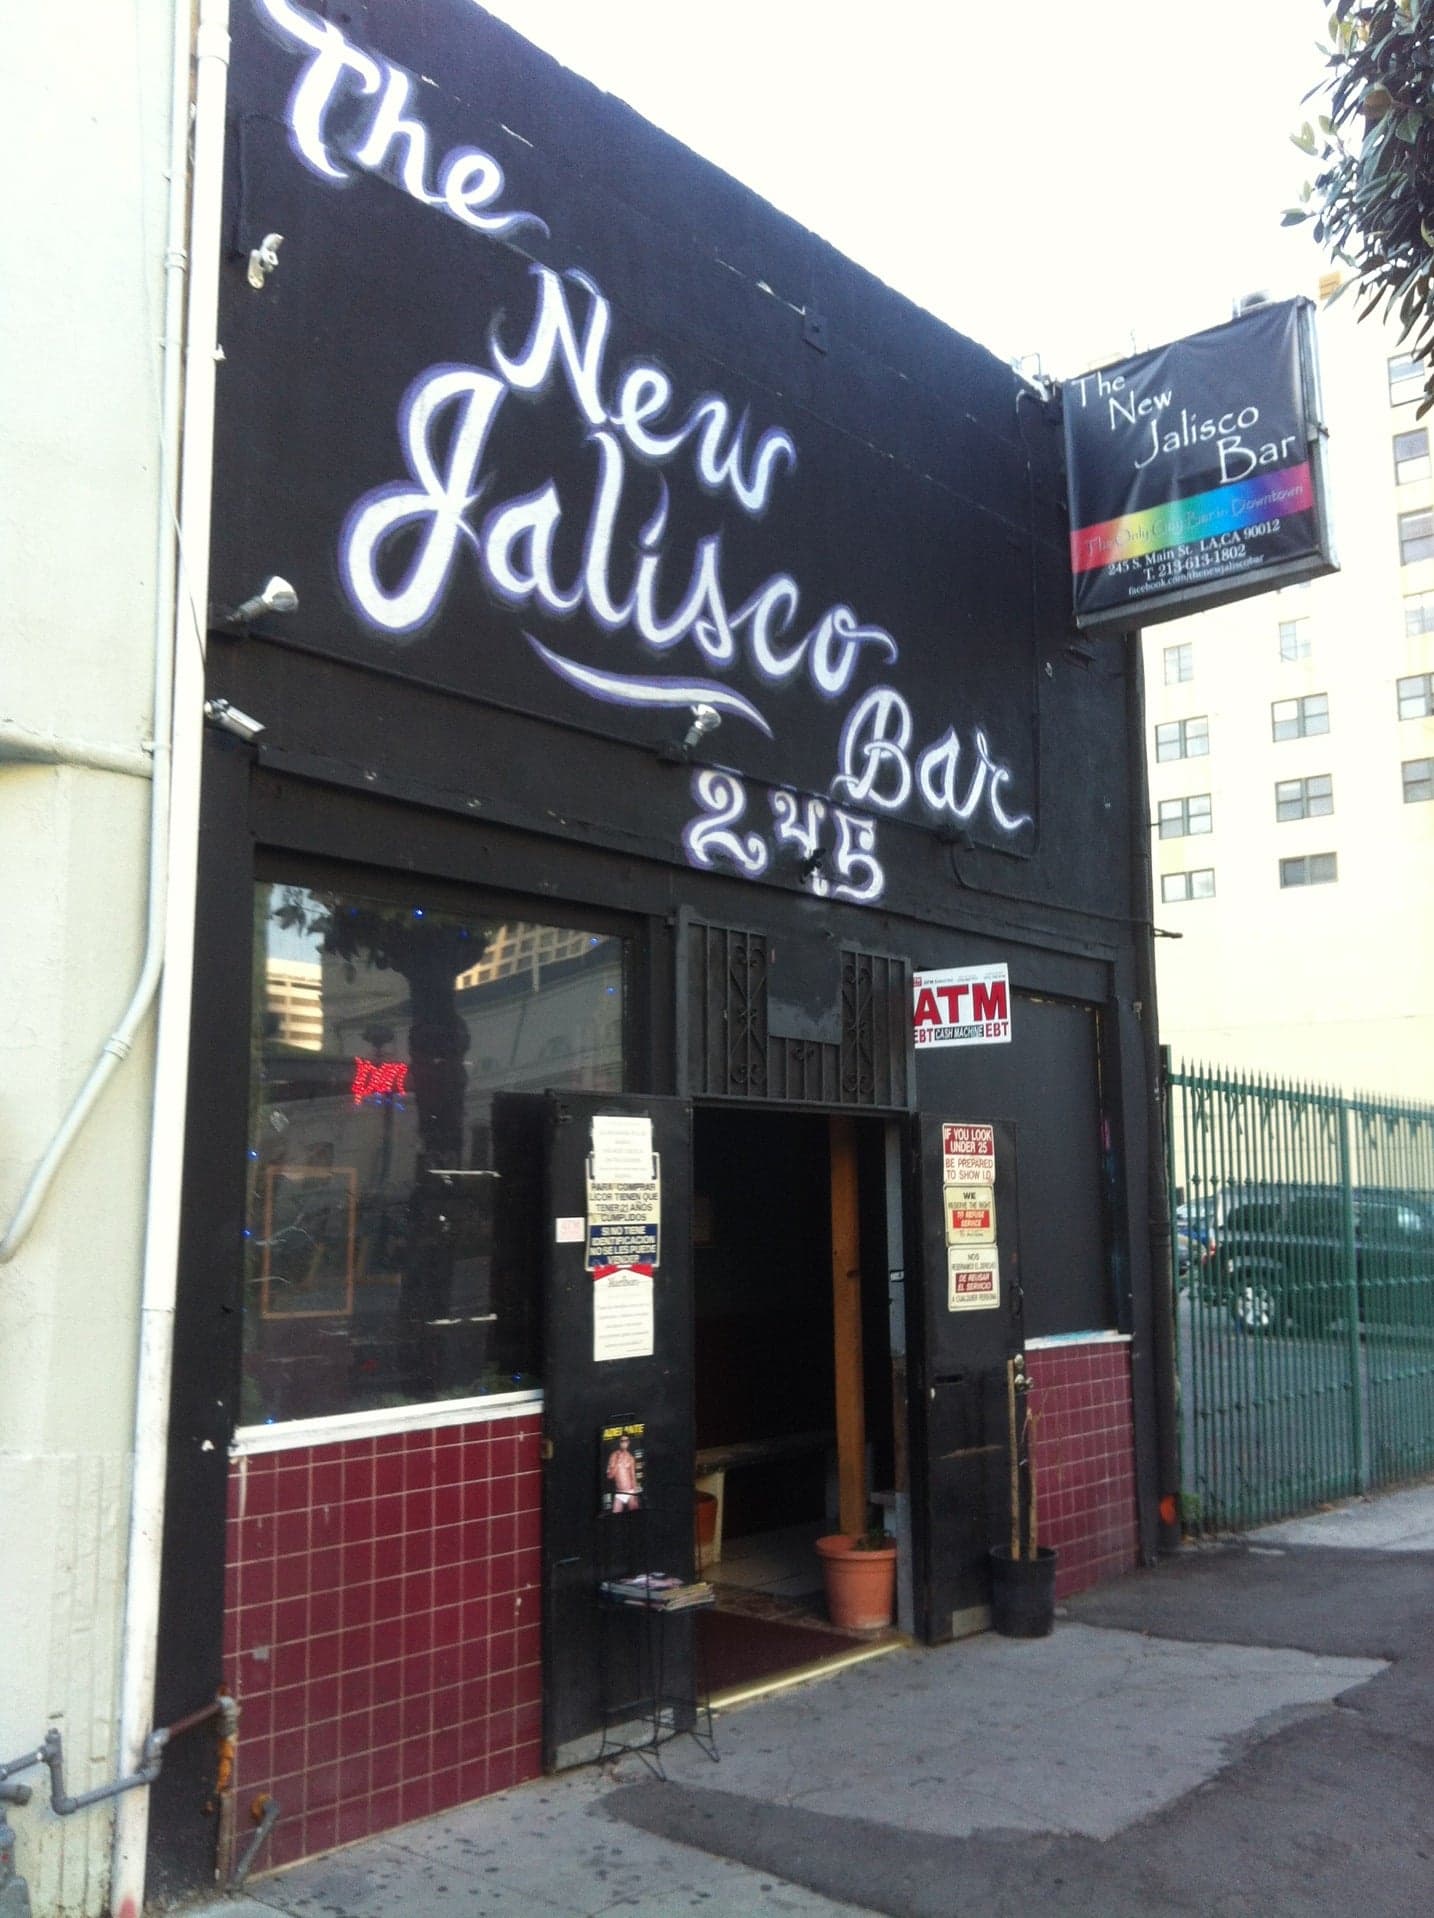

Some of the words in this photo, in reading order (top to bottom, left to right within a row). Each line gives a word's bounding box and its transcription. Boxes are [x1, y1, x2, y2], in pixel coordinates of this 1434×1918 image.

[256, 0, 550, 240] The
[489, 264, 798, 518] New
[1072, 371, 1126, 407] The
[1109, 389, 1172, 430] New
[1134, 406, 1259, 469] Jalisco
[1216, 434, 1296, 484] Bar
[1230, 484, 1304, 516] Downtown
[339, 361, 898, 697] Jalisco
[1107, 556, 1130, 577] 245
[1145, 549, 1175, 568] Main
[1178, 544, 1194, 560] St.
[1243, 518, 1281, 541] 90012
[1143, 568, 1155, 582] T.
[1158, 543, 1247, 578] 213-613-1802
[831, 686, 1033, 831] Bar
[683, 768, 884, 902] 245
[912, 980, 1008, 1027] ATM
[935, 1027, 953, 1041] CASH
[953, 1024, 984, 1040] MACHINE
[985, 1021, 1008, 1038] EBT
[944, 1127, 952, 1140] IF
[954, 1127, 970, 1141] YOU
[971, 1128, 992, 1141] LOOK
[950, 1140, 976, 1153] UNDER
[978, 1141, 988, 1153] 25
[945, 1158, 955, 1168] BE
[958, 1158, 993, 1169] PREPARED
[946, 1169, 956, 1180] TO
[959, 1169, 981, 1180] SHOW
[589, 1192, 612, 1202] LICOR
[614, 1192, 641, 1201] TIENEN
[642, 1192, 658, 1202] QUE
[616, 1182, 656, 1191] COMPRAR
[962, 1191, 976, 1199] WE
[595, 1203, 619, 1212] TENER
[630, 1200, 653, 1212] AÑOS
[599, 1213, 647, 1222] CUMPLIDOS
[623, 1225, 647, 1235] TIENE
[590, 1246, 601, 1256] NO
[603, 1246, 613, 1255] SE
[614, 1245, 629, 1255] LES
[630, 1244, 657, 1254] PUEDE
